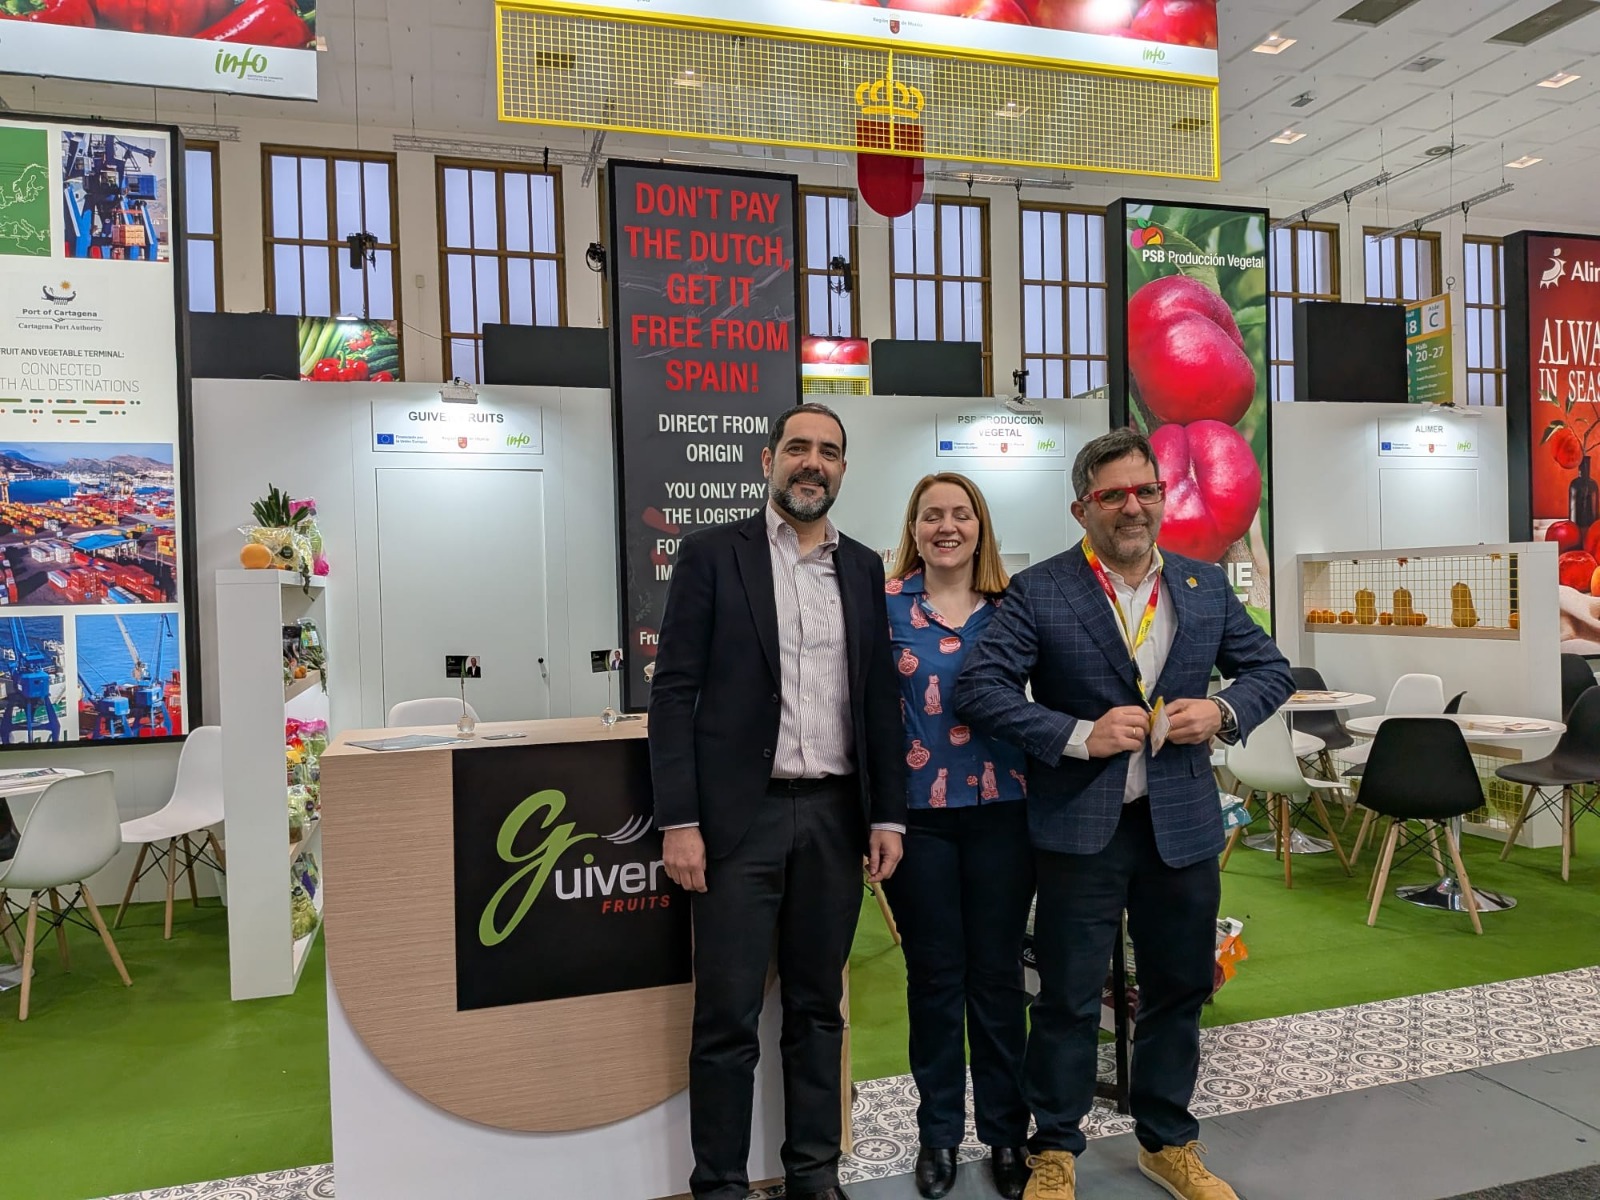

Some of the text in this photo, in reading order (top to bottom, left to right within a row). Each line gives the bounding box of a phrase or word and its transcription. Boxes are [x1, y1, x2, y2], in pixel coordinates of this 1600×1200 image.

[215, 47, 268, 79] info
[1142, 46, 1166, 64] info
[635, 182, 781, 224] DON'T PAY
[624, 225, 791, 272] THE DUTCH,
[1142, 249, 1264, 270] PSB Producción Vegetal
[666, 272, 755, 308] GET IT
[54, 309, 98, 318] Cartagena
[1429, 312, 1439, 327] C
[18, 323, 53, 331] Cartagena
[70, 325, 103, 333] Authority
[631, 314, 789, 352] FREE FROM
[20, 348, 38, 356] AND
[38, 349, 83, 357] VEGETABLE
[84, 350, 125, 359] TERMINAL:
[21, 362, 102, 376] CONNECTED
[665, 359, 759, 393] SPAIN!
[20, 378, 45, 391] ALL
[48, 379, 140, 393] DESTINATIONS
[1539, 368, 1559, 402] IN
[658, 413, 769, 434] DIRECT FROM
[1415, 425, 1444, 433] ALIMER
[506, 432, 530, 448] info
[979, 428, 1022, 437] VEGETAL
[686, 443, 743, 463] ORIGIN
[1037, 438, 1056, 452] info
[665, 482, 766, 499] YOU ONLY PAY
[662, 508, 692, 524] THE
[640, 631, 659, 645] Fru
[601, 894, 671, 914] FRUITS
